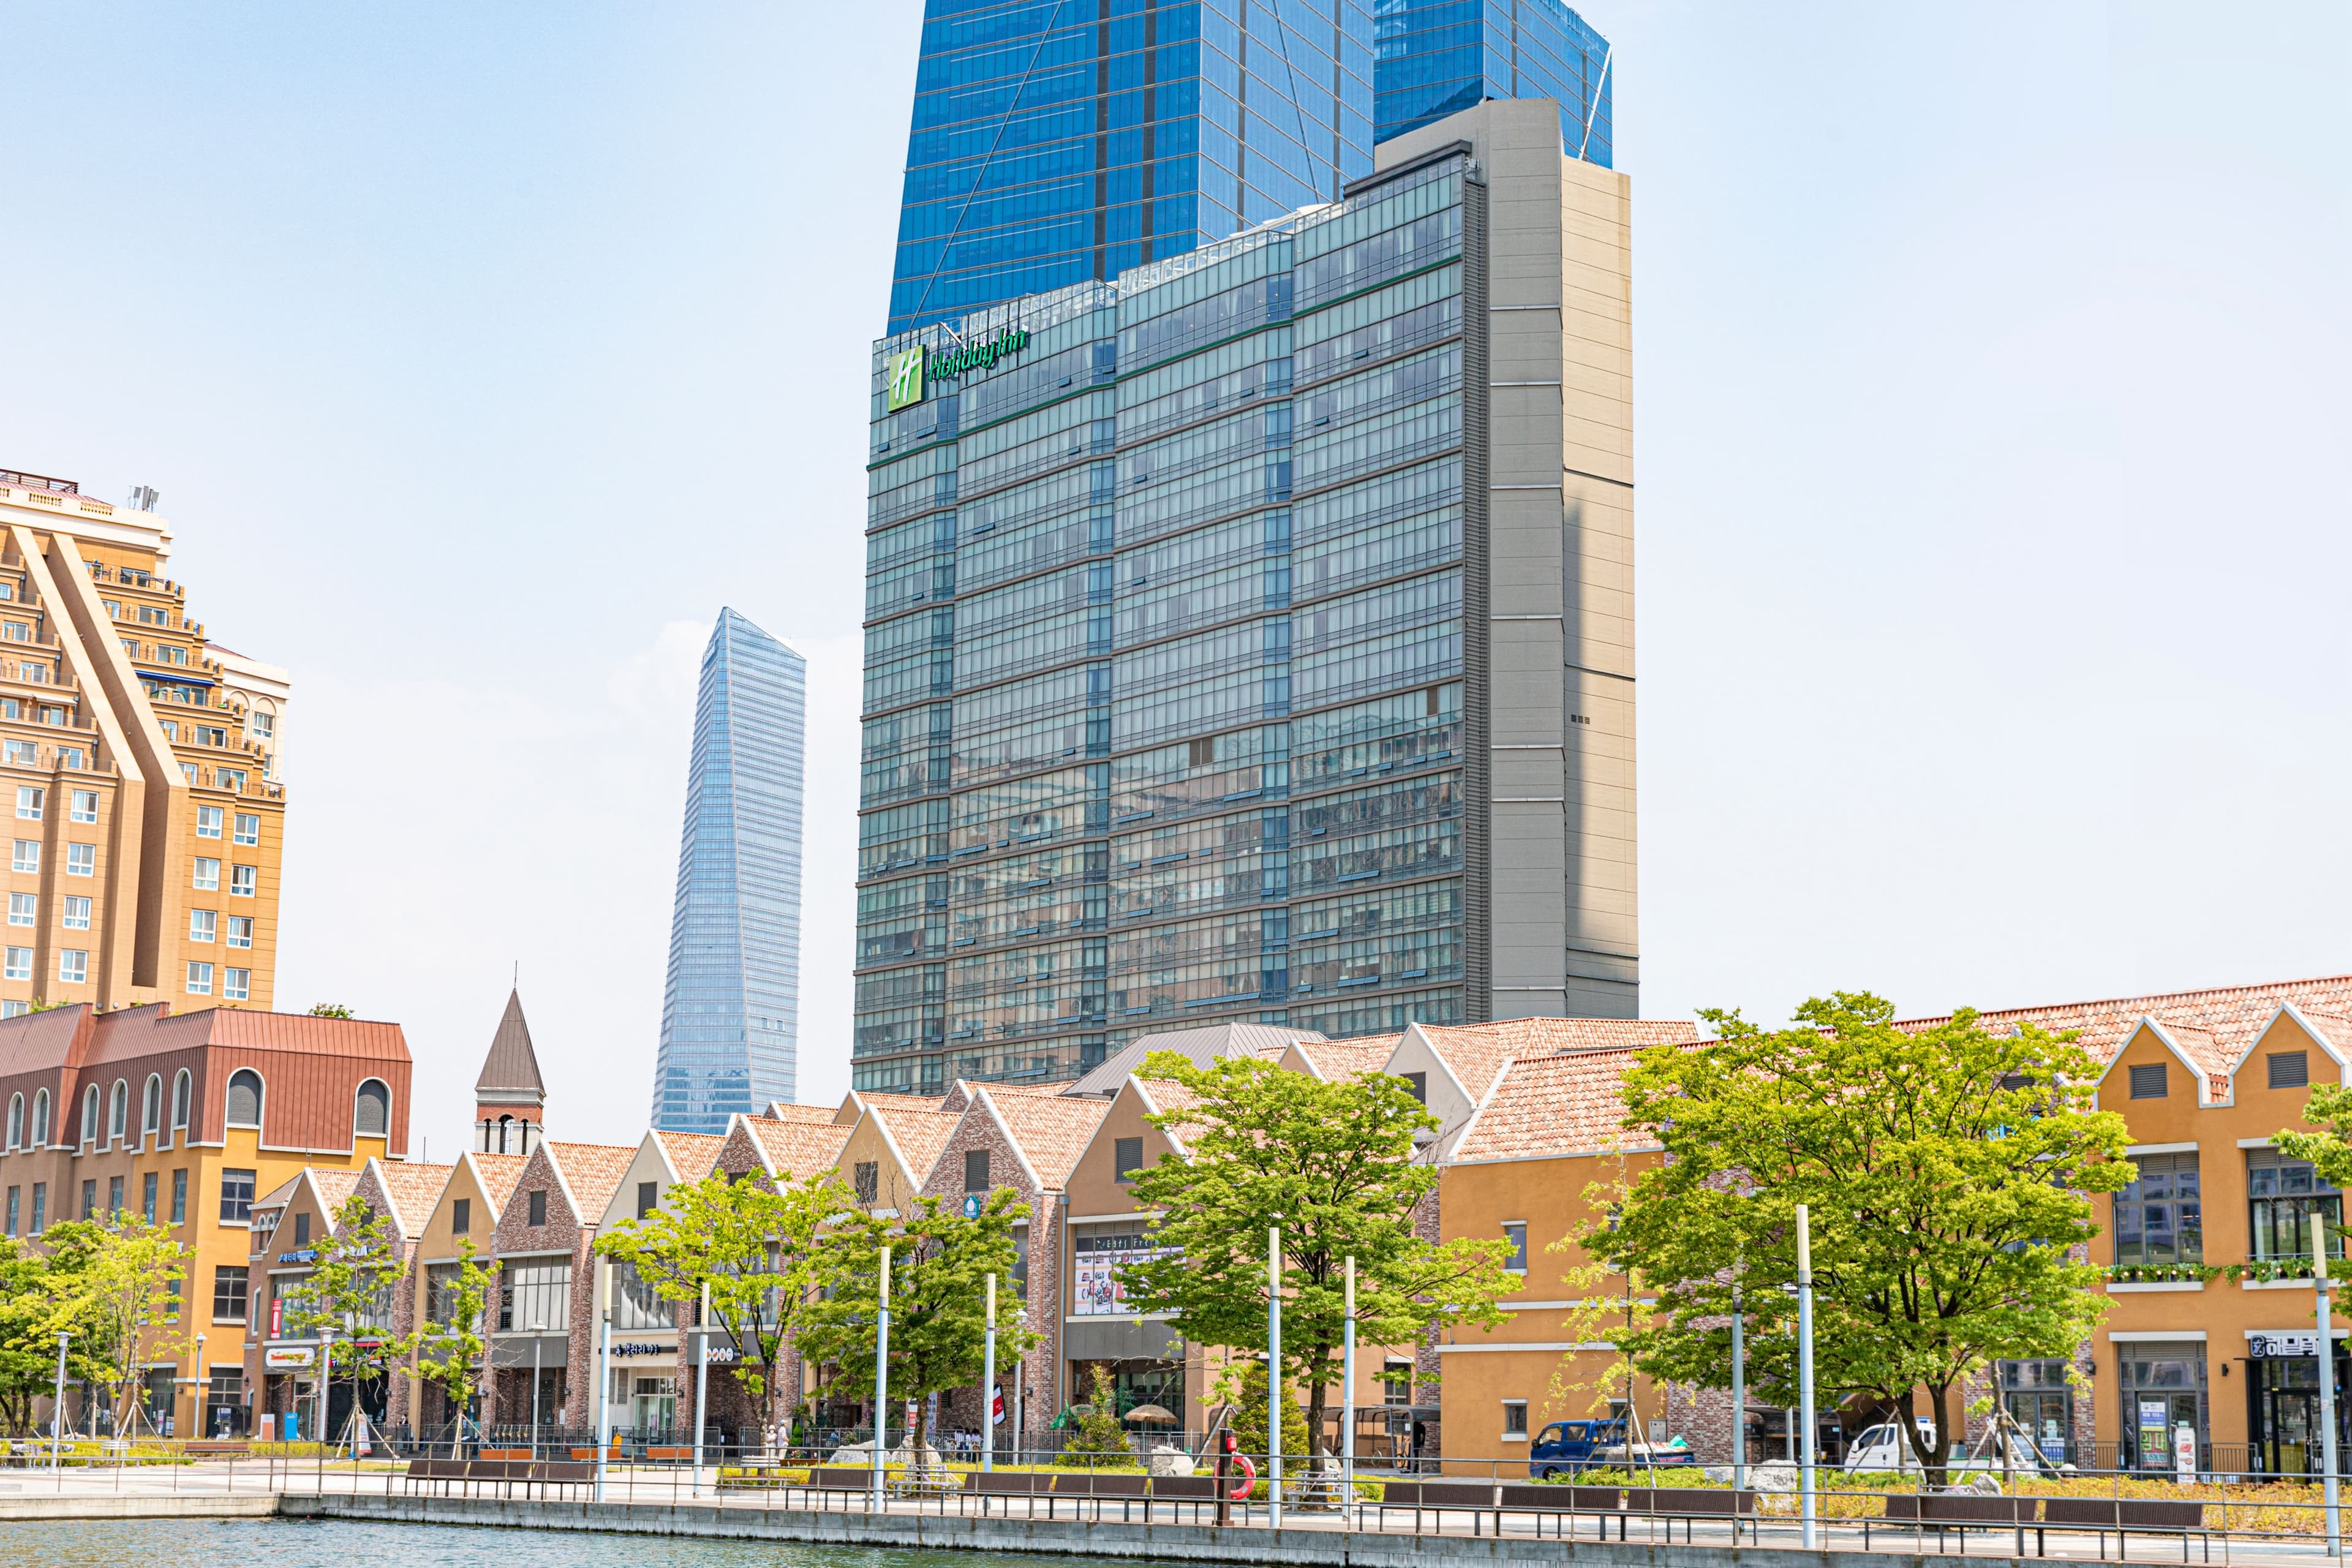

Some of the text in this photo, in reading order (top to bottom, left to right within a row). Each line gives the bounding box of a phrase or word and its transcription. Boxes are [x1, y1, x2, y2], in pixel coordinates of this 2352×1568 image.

[928, 328, 1026, 382] Holiday Inn
[1107, 1238, 1127, 1250] Eats
